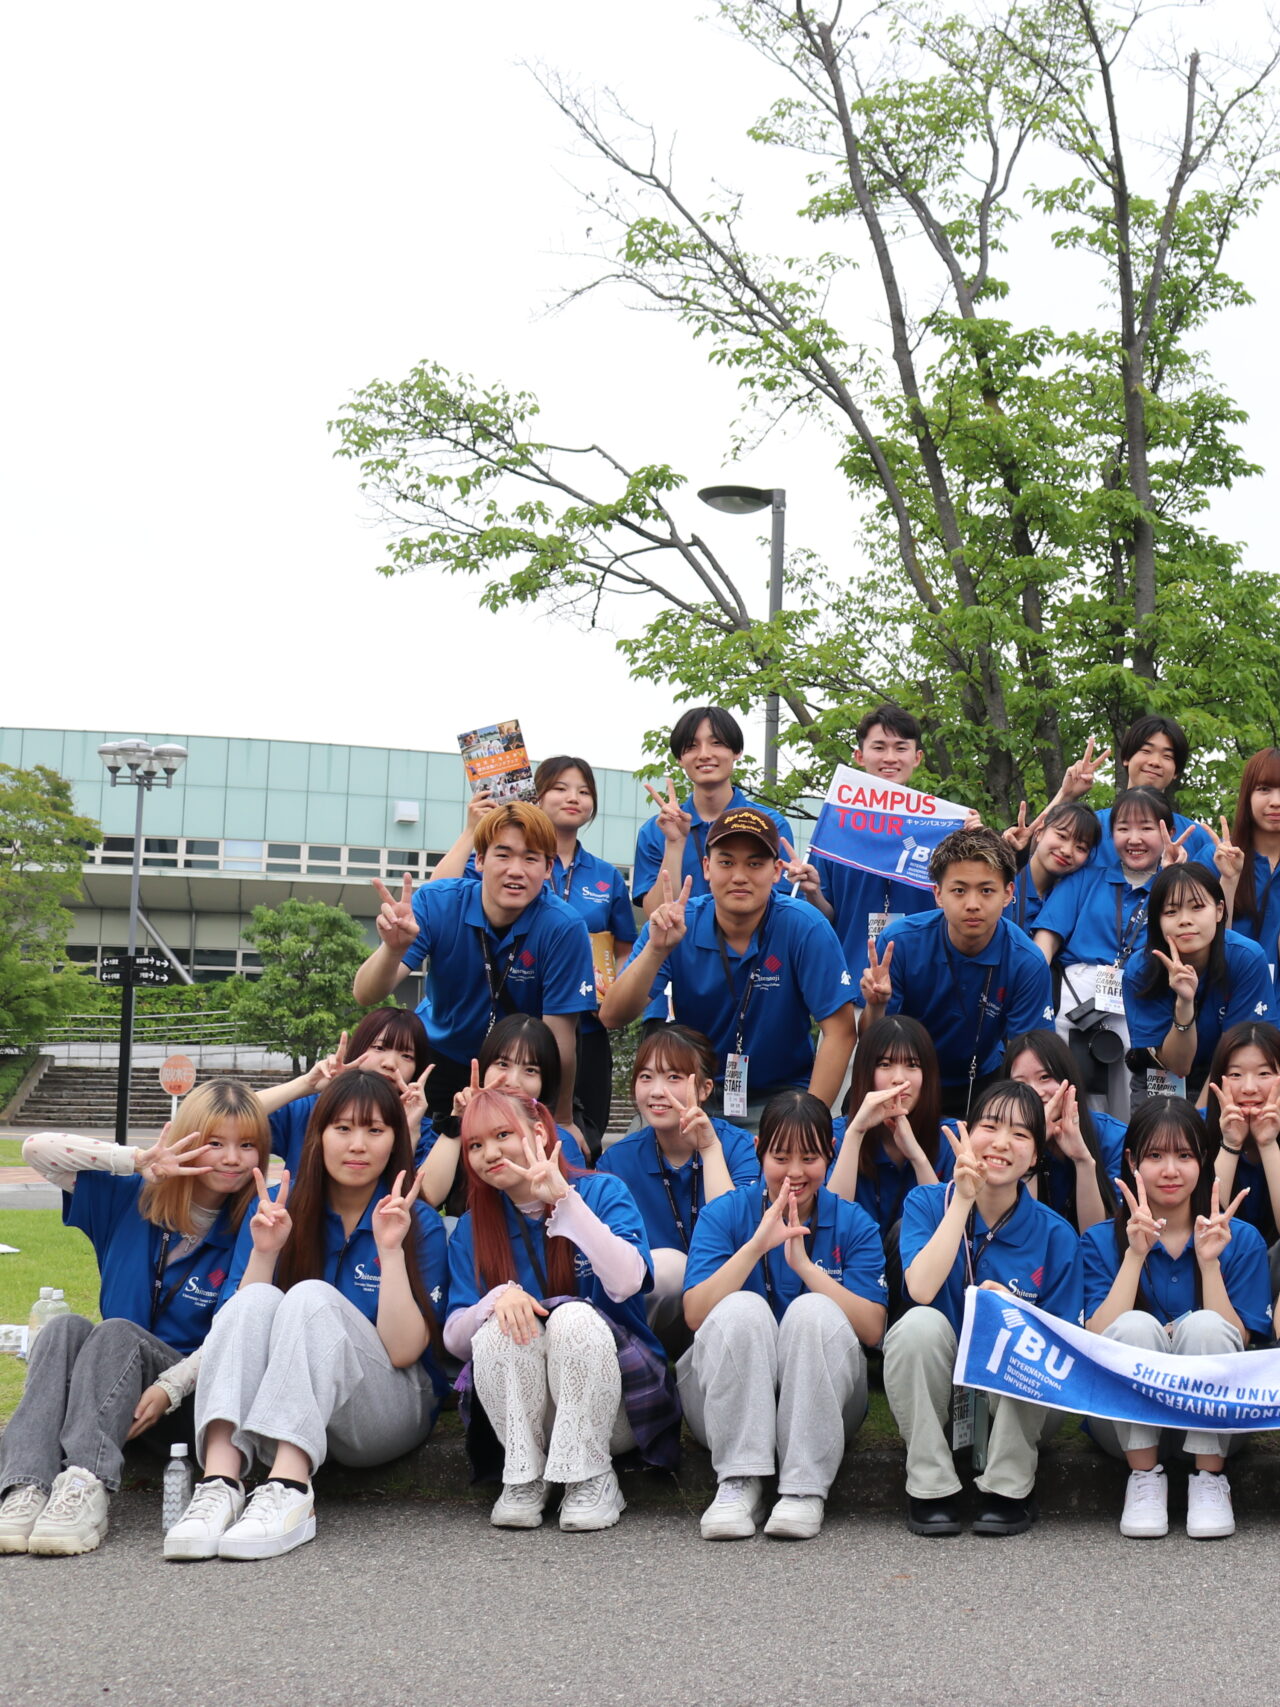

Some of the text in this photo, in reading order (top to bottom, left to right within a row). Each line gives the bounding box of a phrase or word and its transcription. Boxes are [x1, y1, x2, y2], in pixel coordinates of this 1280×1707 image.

[837, 784, 937, 815] CAMPUS
[834, 807, 904, 836] TOUR
[905, 818, 961, 828] キャンパスツアー
[1096, 970, 1115, 979] OPEN
[724, 1069, 743, 1079] CAMPUS
[1147, 1075, 1166, 1084] OPEN
[724, 1079, 743, 1093] STAFF
[1147, 1083, 1177, 1092] CAMPUS
[1006, 1365, 1042, 1389] BUDDHIST
[1009, 1355, 1063, 1392] INTERNATIONAL
[1132, 1362, 1229, 1399] SHITENNOJI
[1003, 1373, 1044, 1399] UNIVERSITY
